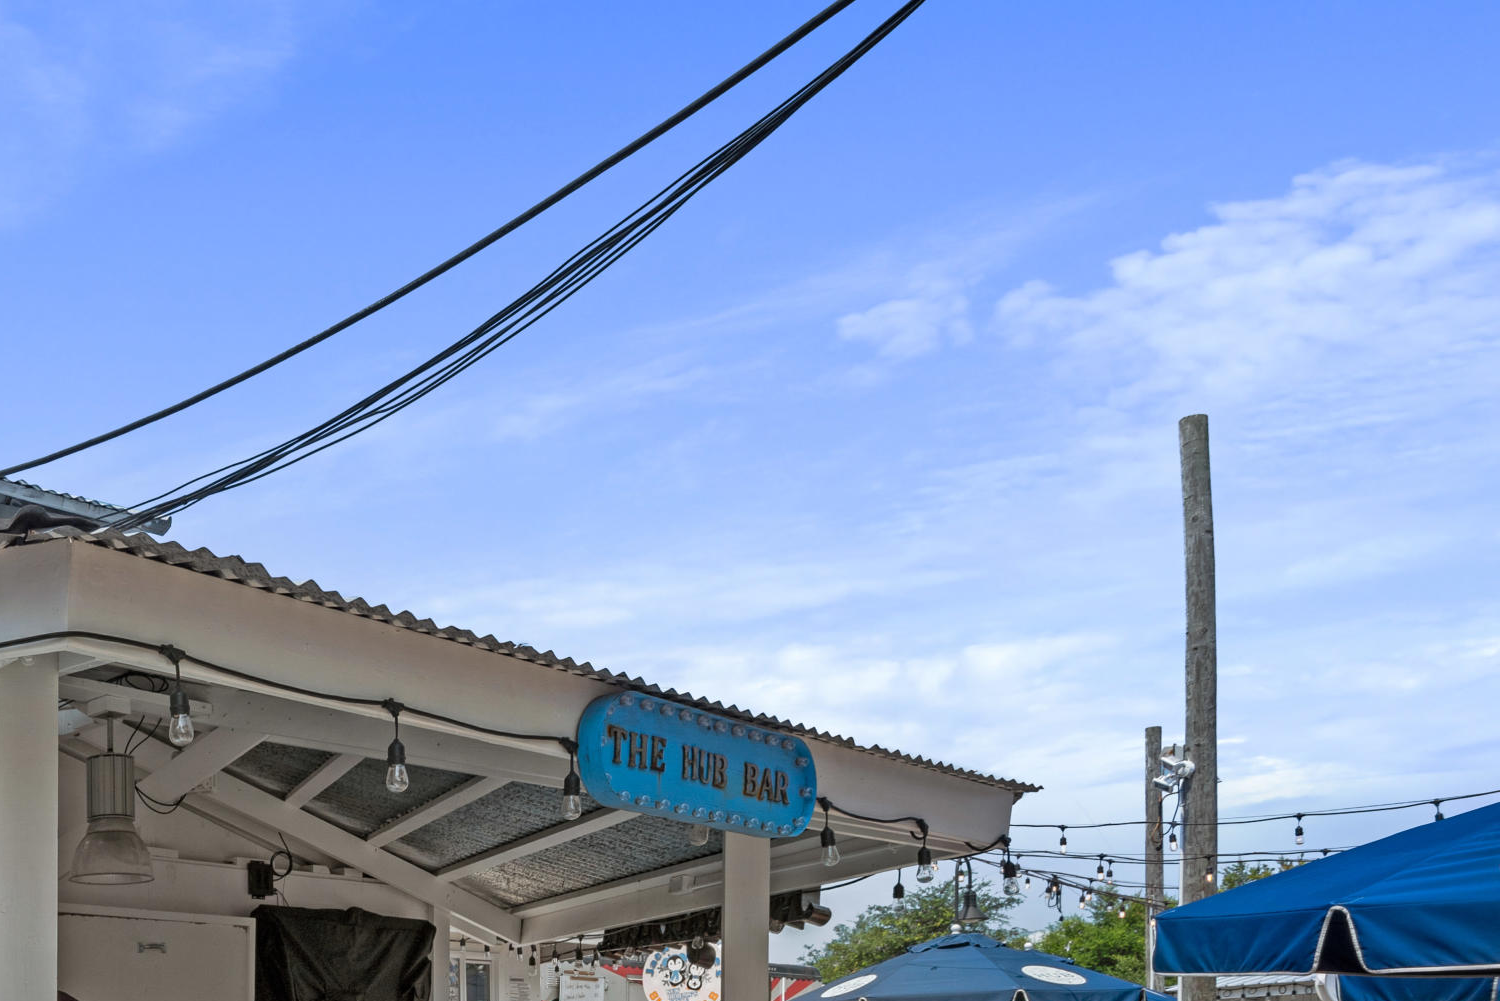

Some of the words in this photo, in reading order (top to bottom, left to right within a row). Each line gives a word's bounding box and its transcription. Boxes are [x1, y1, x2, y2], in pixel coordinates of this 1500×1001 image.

[607, 724, 667, 772] THE
[682, 744, 729, 790] HUB
[742, 761, 790, 806] BAR
